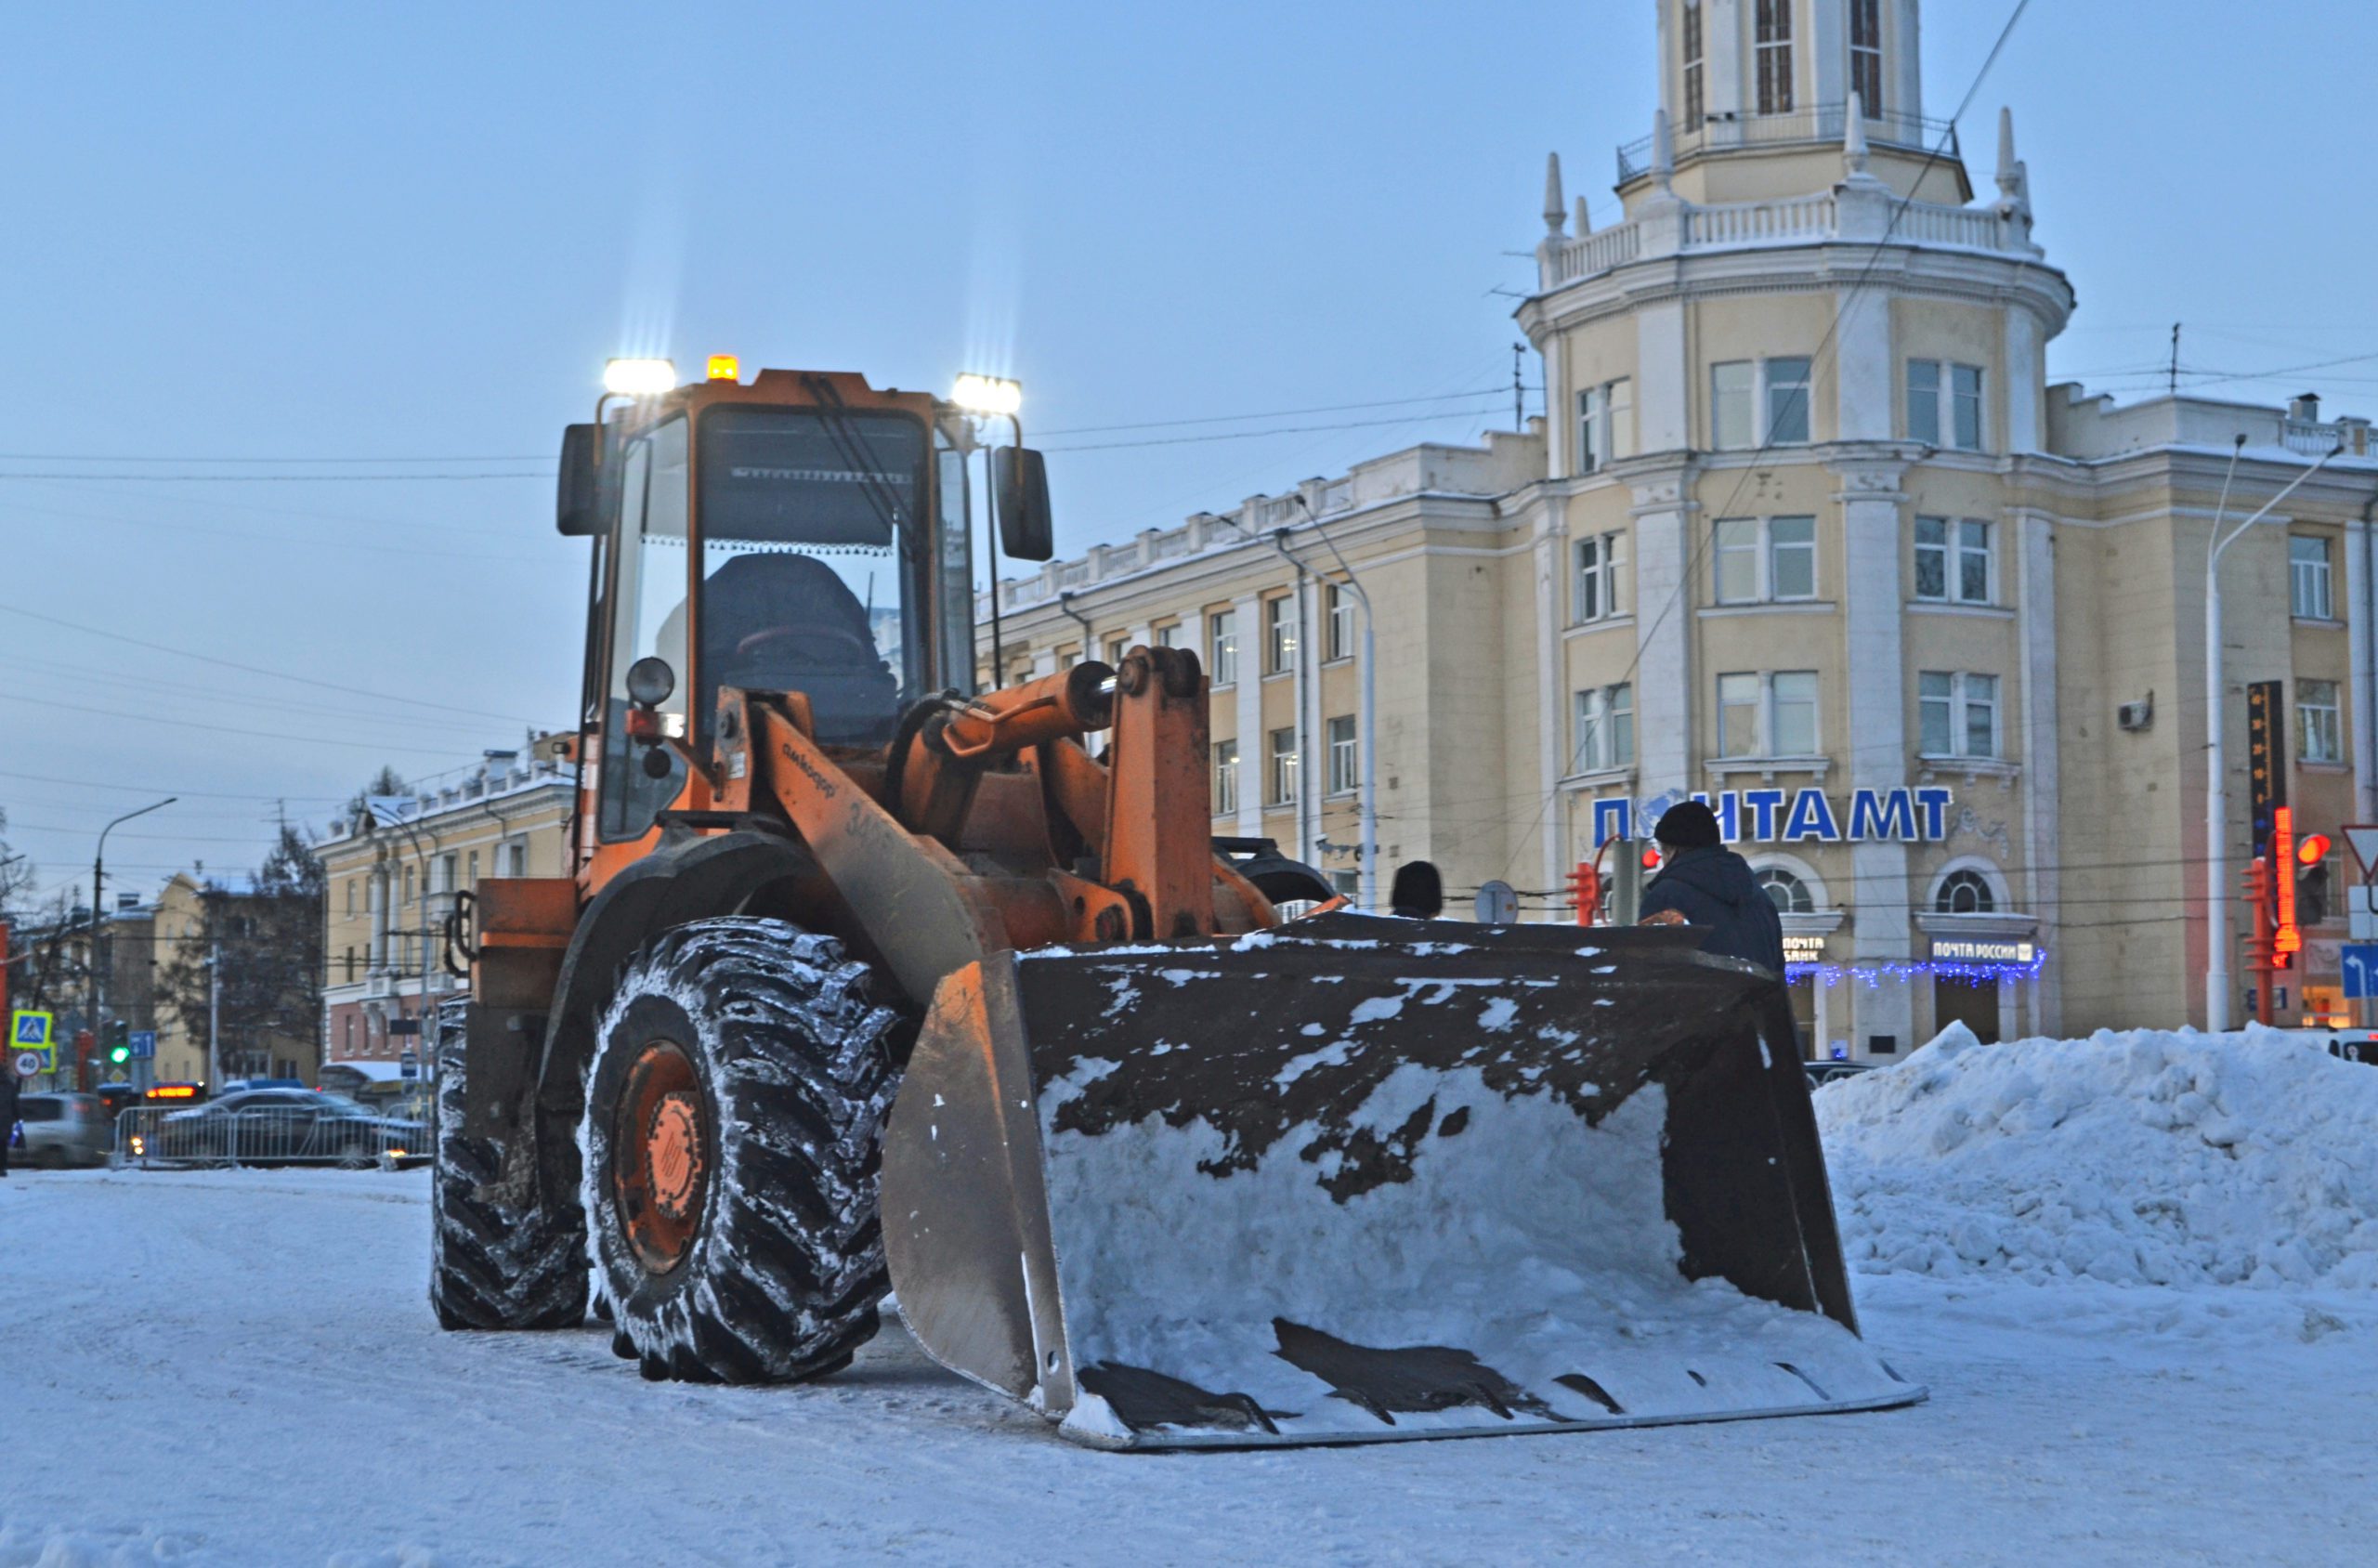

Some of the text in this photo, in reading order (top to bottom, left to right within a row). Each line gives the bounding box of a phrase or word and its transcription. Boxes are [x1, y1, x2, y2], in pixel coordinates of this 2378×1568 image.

[1783, 937, 1825, 949] ПОЧТА
[1784, 950, 1819, 962] БАНК
[1933, 942, 2017, 960] ПОЧТА РОССИИ
[19, 1057, 36, 1069] 40
